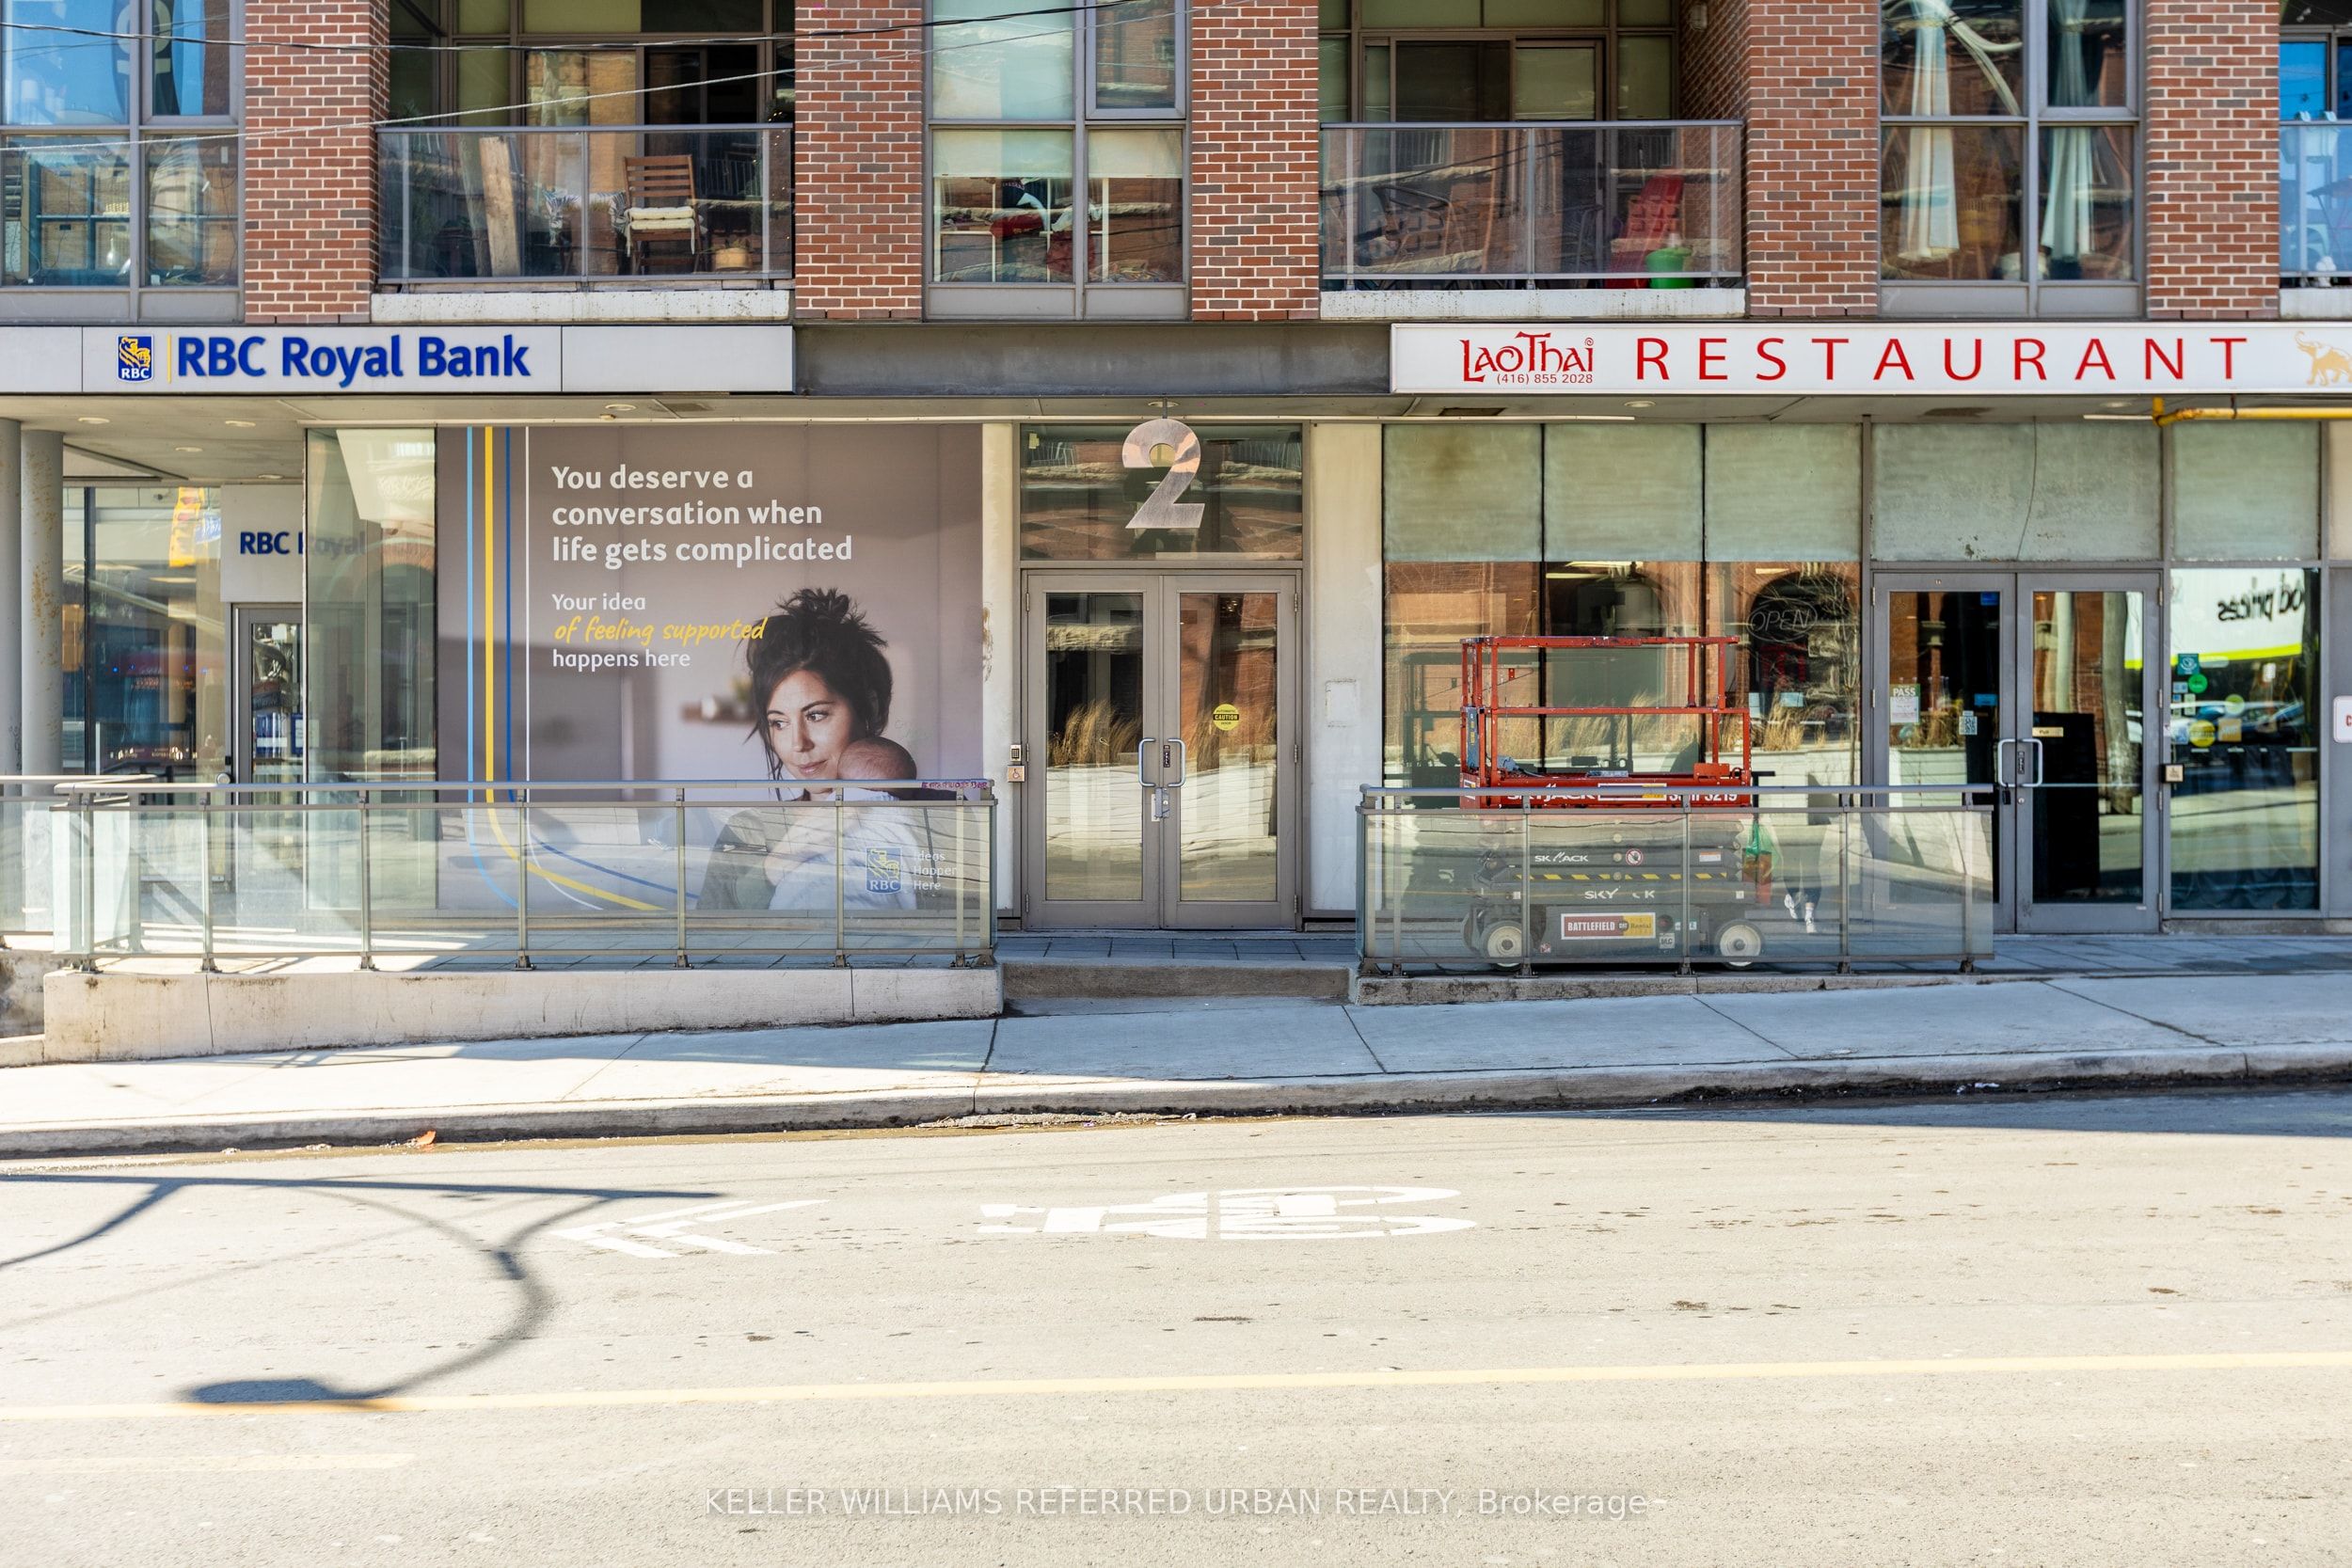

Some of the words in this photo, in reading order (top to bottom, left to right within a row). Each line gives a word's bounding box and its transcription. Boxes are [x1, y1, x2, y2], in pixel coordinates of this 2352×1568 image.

[179, 337, 266, 377] RBC
[283, 335, 403, 388] Royal
[419, 335, 531, 377] Bank
[1636, 338, 2247, 381] RESTAURANT
[121, 369, 151, 378] RBC
[1497, 374, 1530, 385] (416)
[1534, 374, 1557, 383] 855
[1563, 374, 1593, 383] 2028
[551, 467, 601, 488] You
[610, 465, 729, 488] deserve
[737, 471, 753, 487] a
[1122, 419, 1205, 529] 2
[551, 500, 739, 525] conversation
[748, 499, 822, 524] when
[240, 531, 290, 554] RBC
[552, 536, 597, 561] life
[605, 539, 667, 569] gets
[675, 535, 852, 567] complicated
[551, 594, 597, 610] Your
[602, 593, 646, 610] idea
[554, 616, 584, 645] of
[585, 617, 655, 646] feeling
[662, 617, 767, 645] supported
[1751, 609, 1810, 633] OPEN
[552, 649, 639, 672] happens
[645, 649, 691, 667] here
[870, 880, 898, 891] RBC
[914, 880, 942, 891] Here
[1567, 921, 1615, 931] BATTLEFIELD
